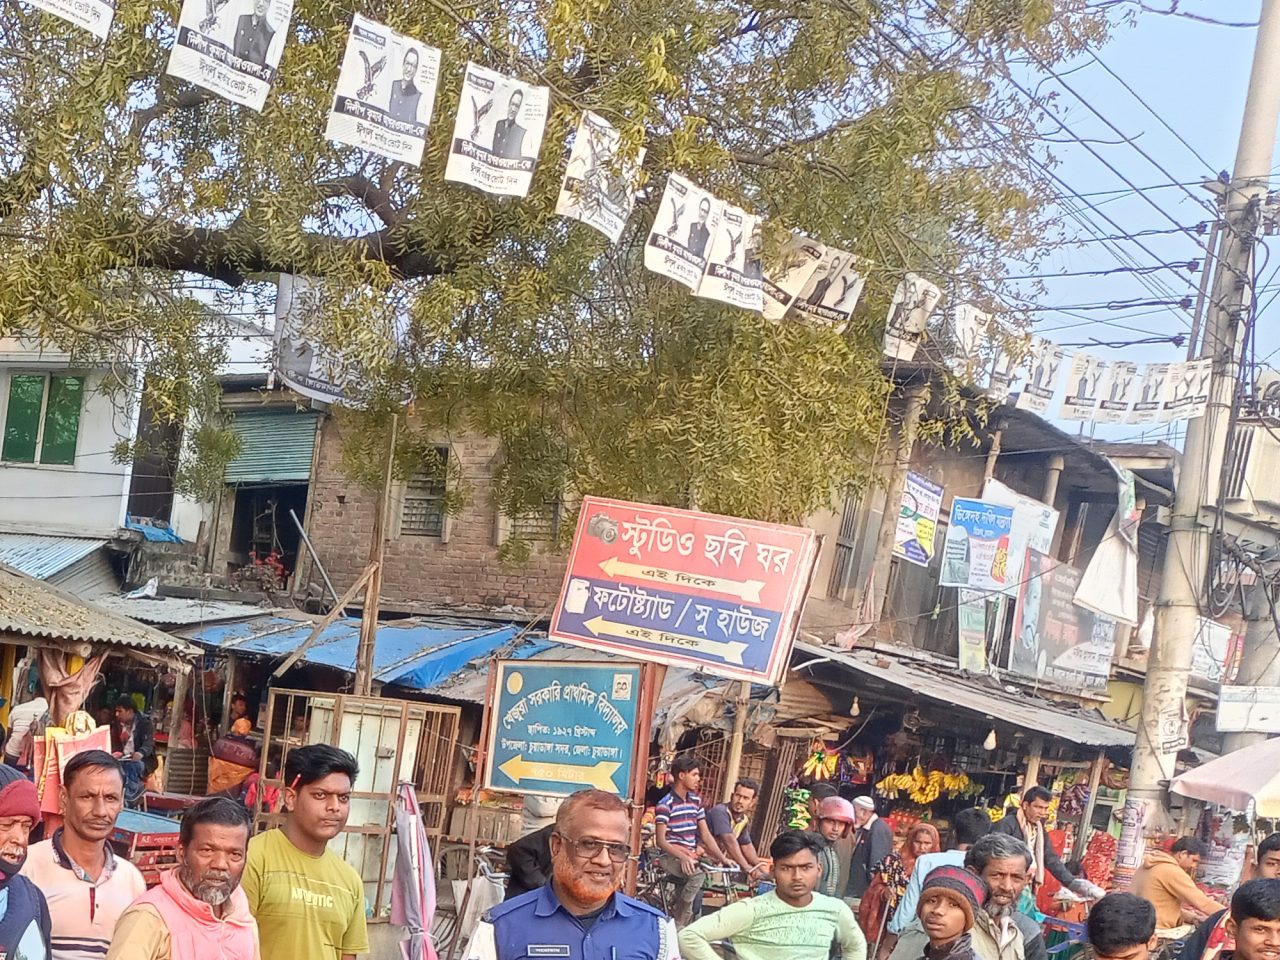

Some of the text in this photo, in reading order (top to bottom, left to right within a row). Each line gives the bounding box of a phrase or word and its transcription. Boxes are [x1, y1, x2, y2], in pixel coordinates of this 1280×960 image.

[622, 514, 794, 576] স্টুডিও ছবি ঘর
[641, 568, 716, 588] এই দিকে
[716, 606, 772, 641] হাউজ
[625, 629, 701, 648] এই দিকে
